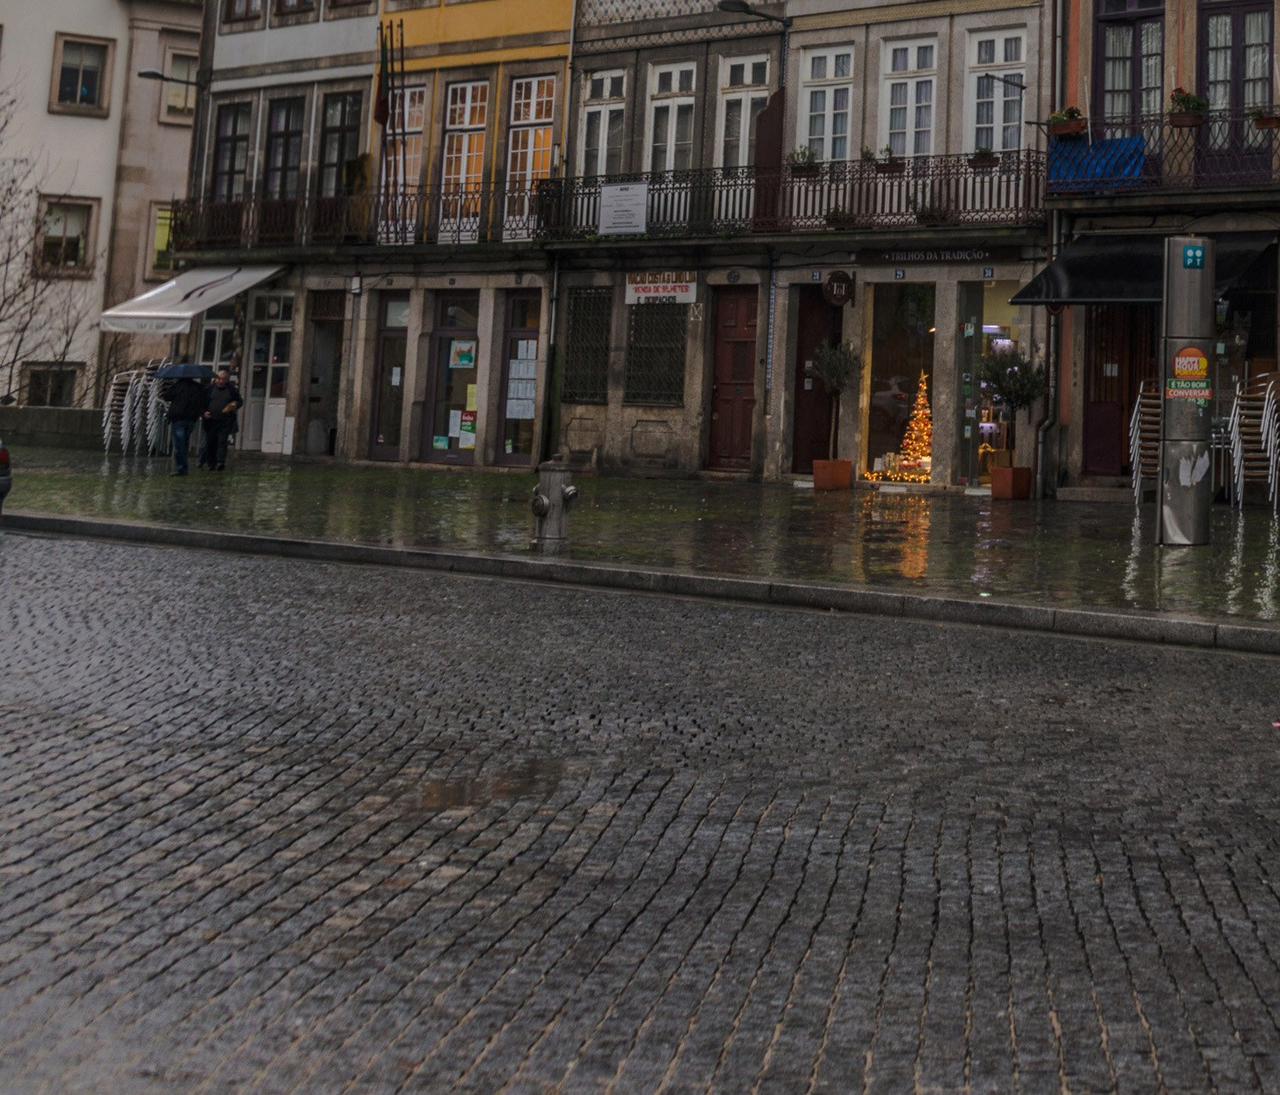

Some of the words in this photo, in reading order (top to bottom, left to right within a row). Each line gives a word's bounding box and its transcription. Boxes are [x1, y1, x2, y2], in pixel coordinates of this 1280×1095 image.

[890, 251, 925, 261] TRILHOS
[926, 251, 938, 260] DA
[940, 248, 984, 262] TRADIÇÃO
[1175, 356, 1199, 364] HAPPY
[1175, 363, 1199, 371] HOUR
[1168, 389, 1211, 397] CONVERSAR
